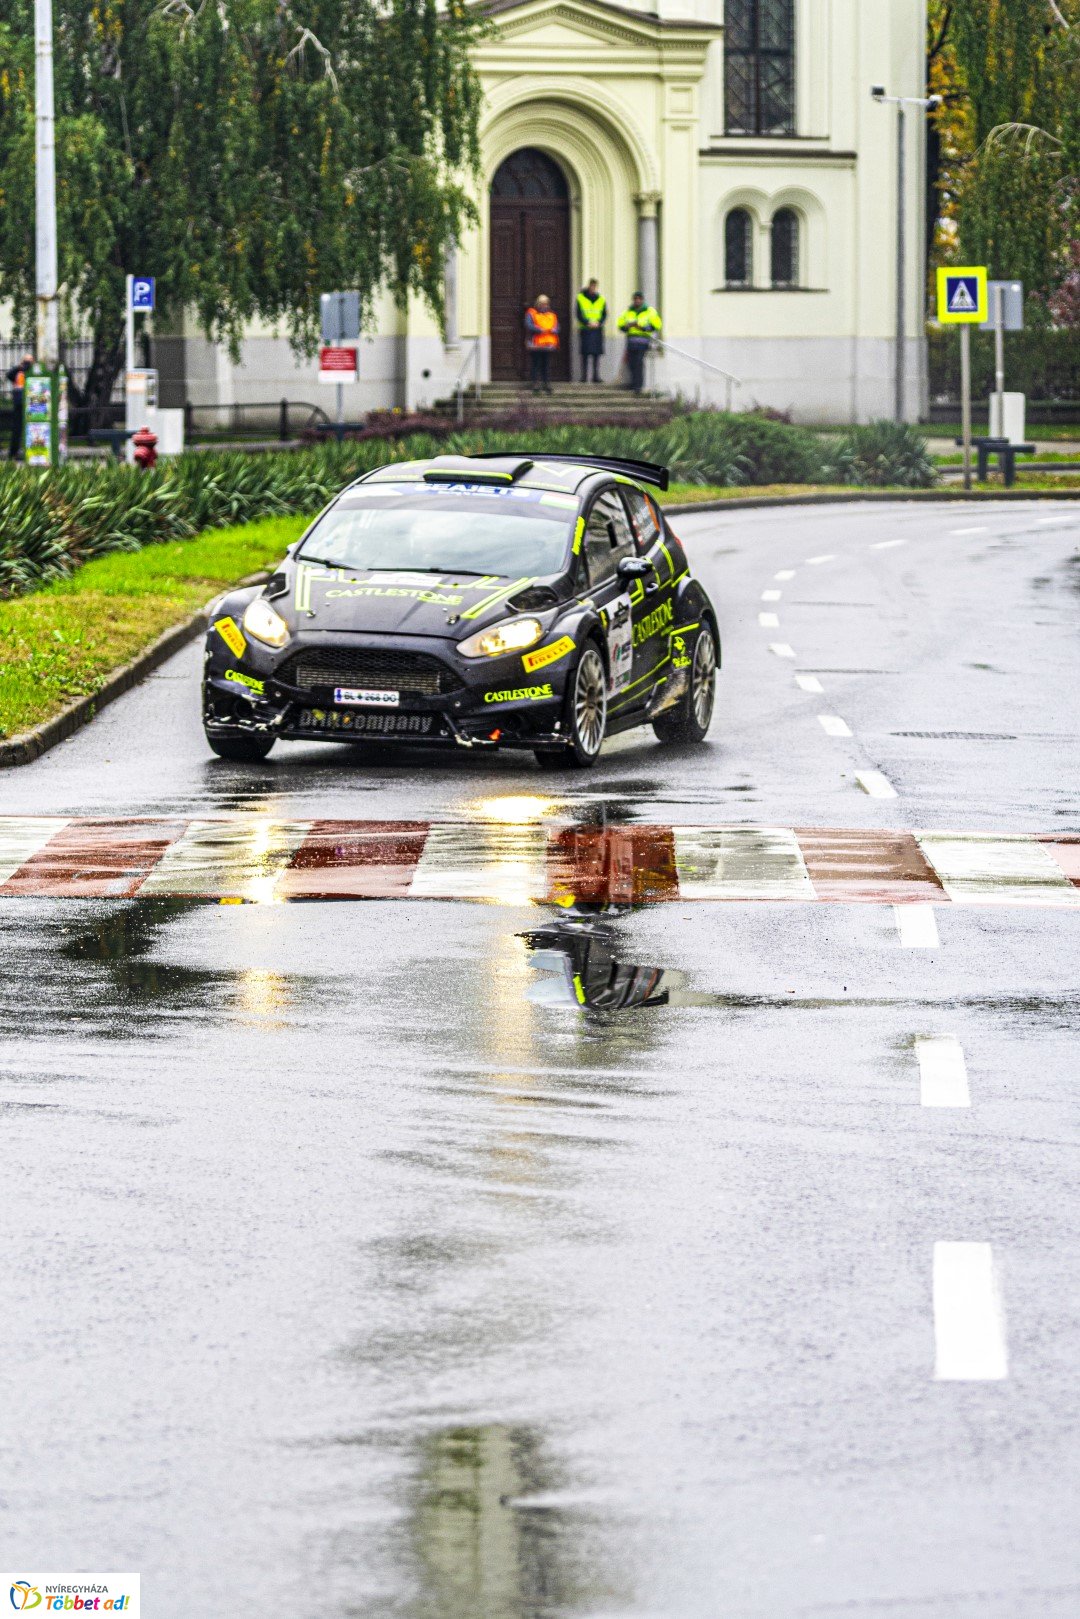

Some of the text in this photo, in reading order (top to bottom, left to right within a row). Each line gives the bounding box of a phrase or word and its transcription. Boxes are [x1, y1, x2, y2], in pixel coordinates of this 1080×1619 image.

[134, 281, 151, 302] P
[324, 587, 464, 605] CASTLESTONE
[484, 683, 554, 703] CASTLESTONE
